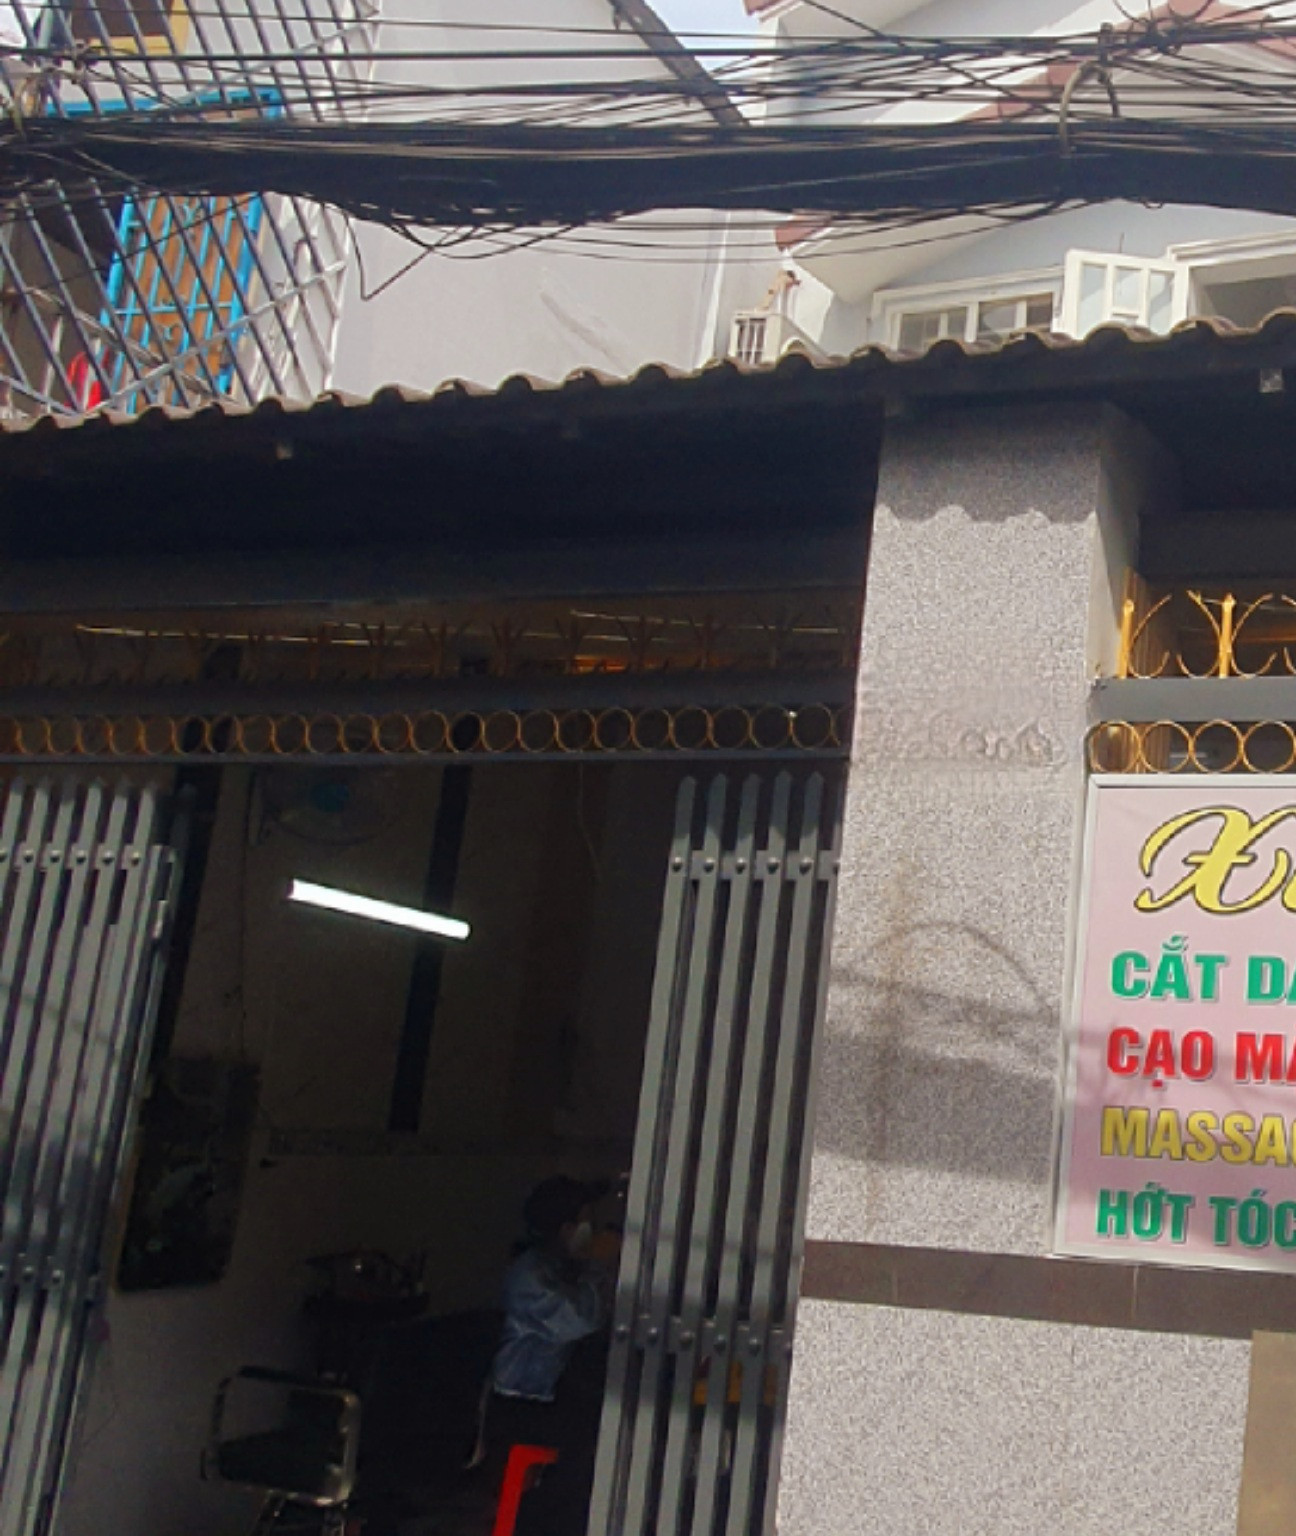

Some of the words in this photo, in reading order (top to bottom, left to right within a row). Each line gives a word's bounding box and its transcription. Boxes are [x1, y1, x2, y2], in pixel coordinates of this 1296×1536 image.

[1111, 935, 1229, 1001] CẮT
[1107, 1026, 1217, 1090] CẠO
[1096, 1182, 1194, 1243] HỚT
